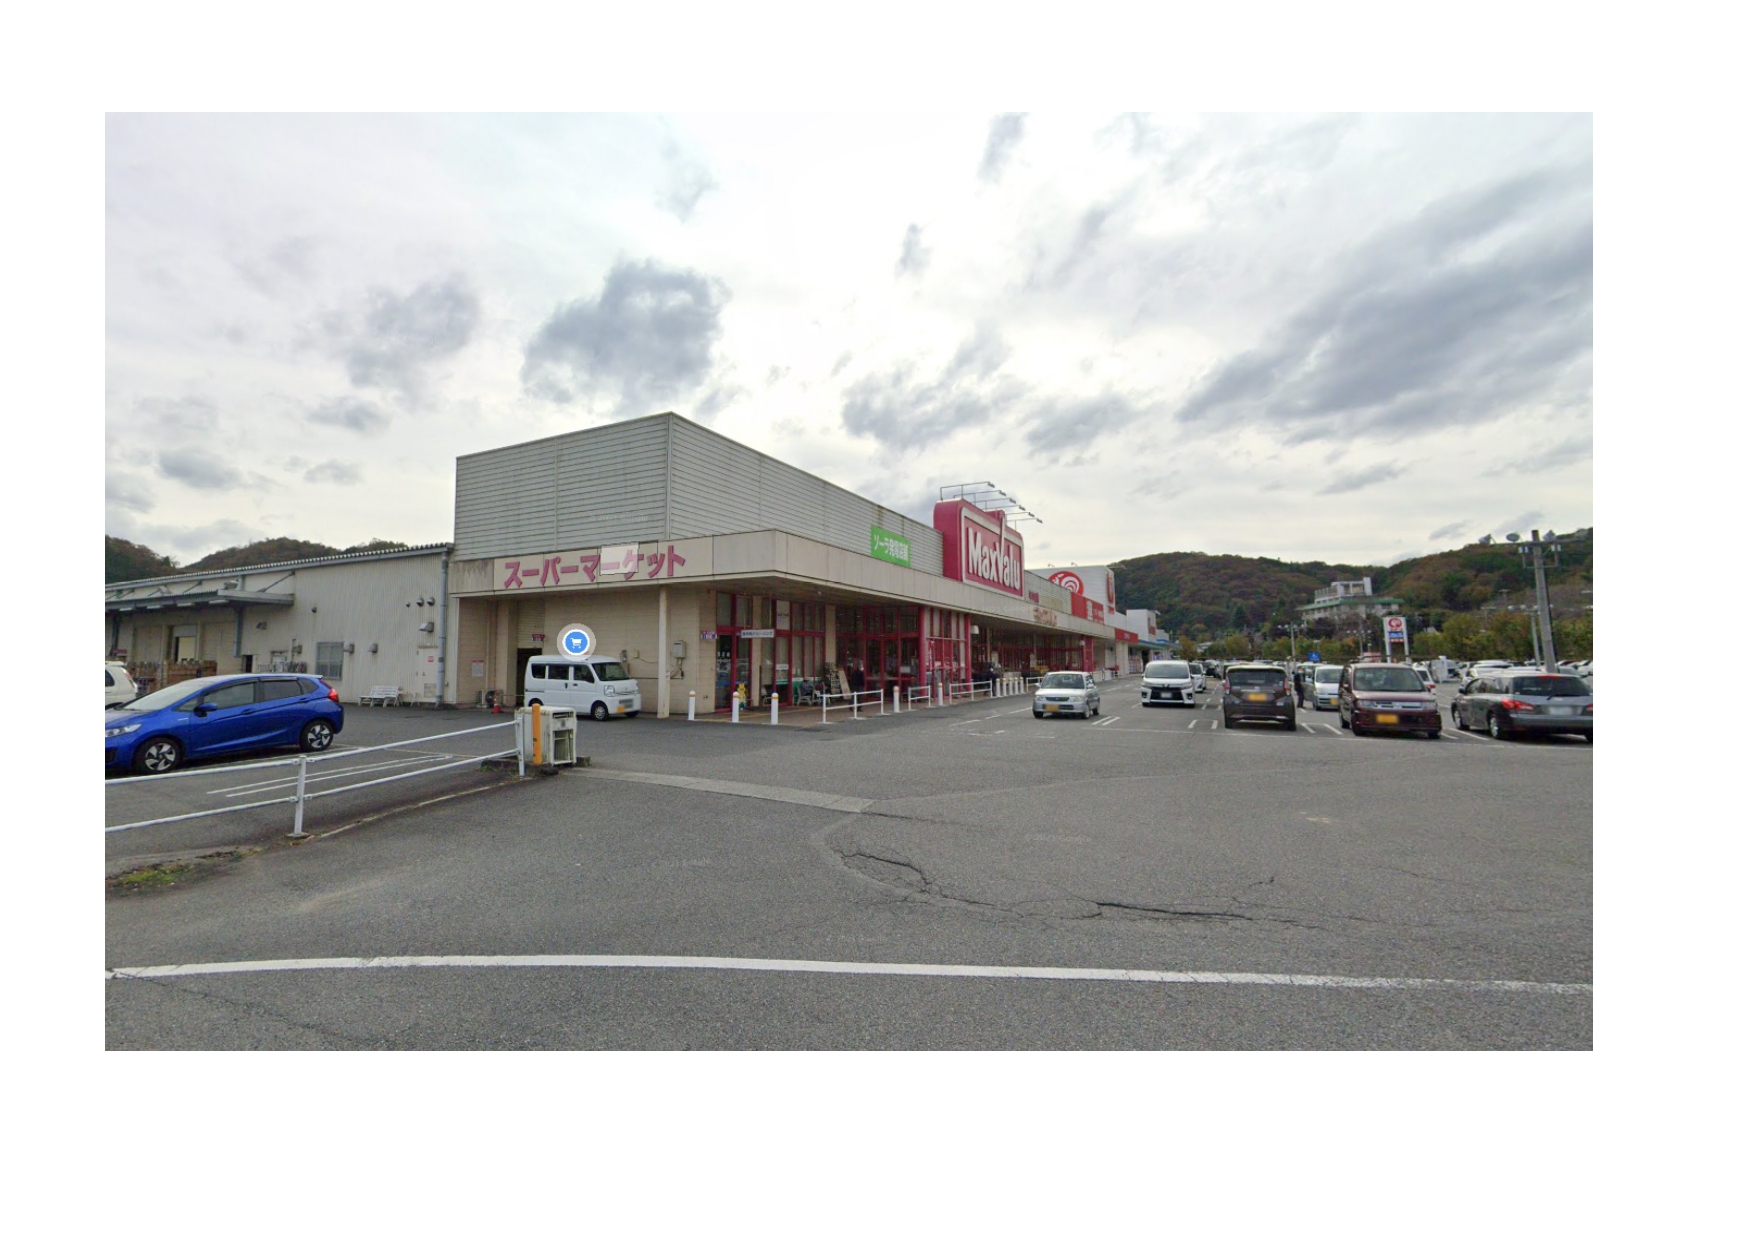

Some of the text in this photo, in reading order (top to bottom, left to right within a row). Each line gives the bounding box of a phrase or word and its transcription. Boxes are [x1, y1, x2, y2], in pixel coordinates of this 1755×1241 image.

[504, 545, 686, 589] スーパーマーケット
[968, 521, 1021, 590] MaxValu
